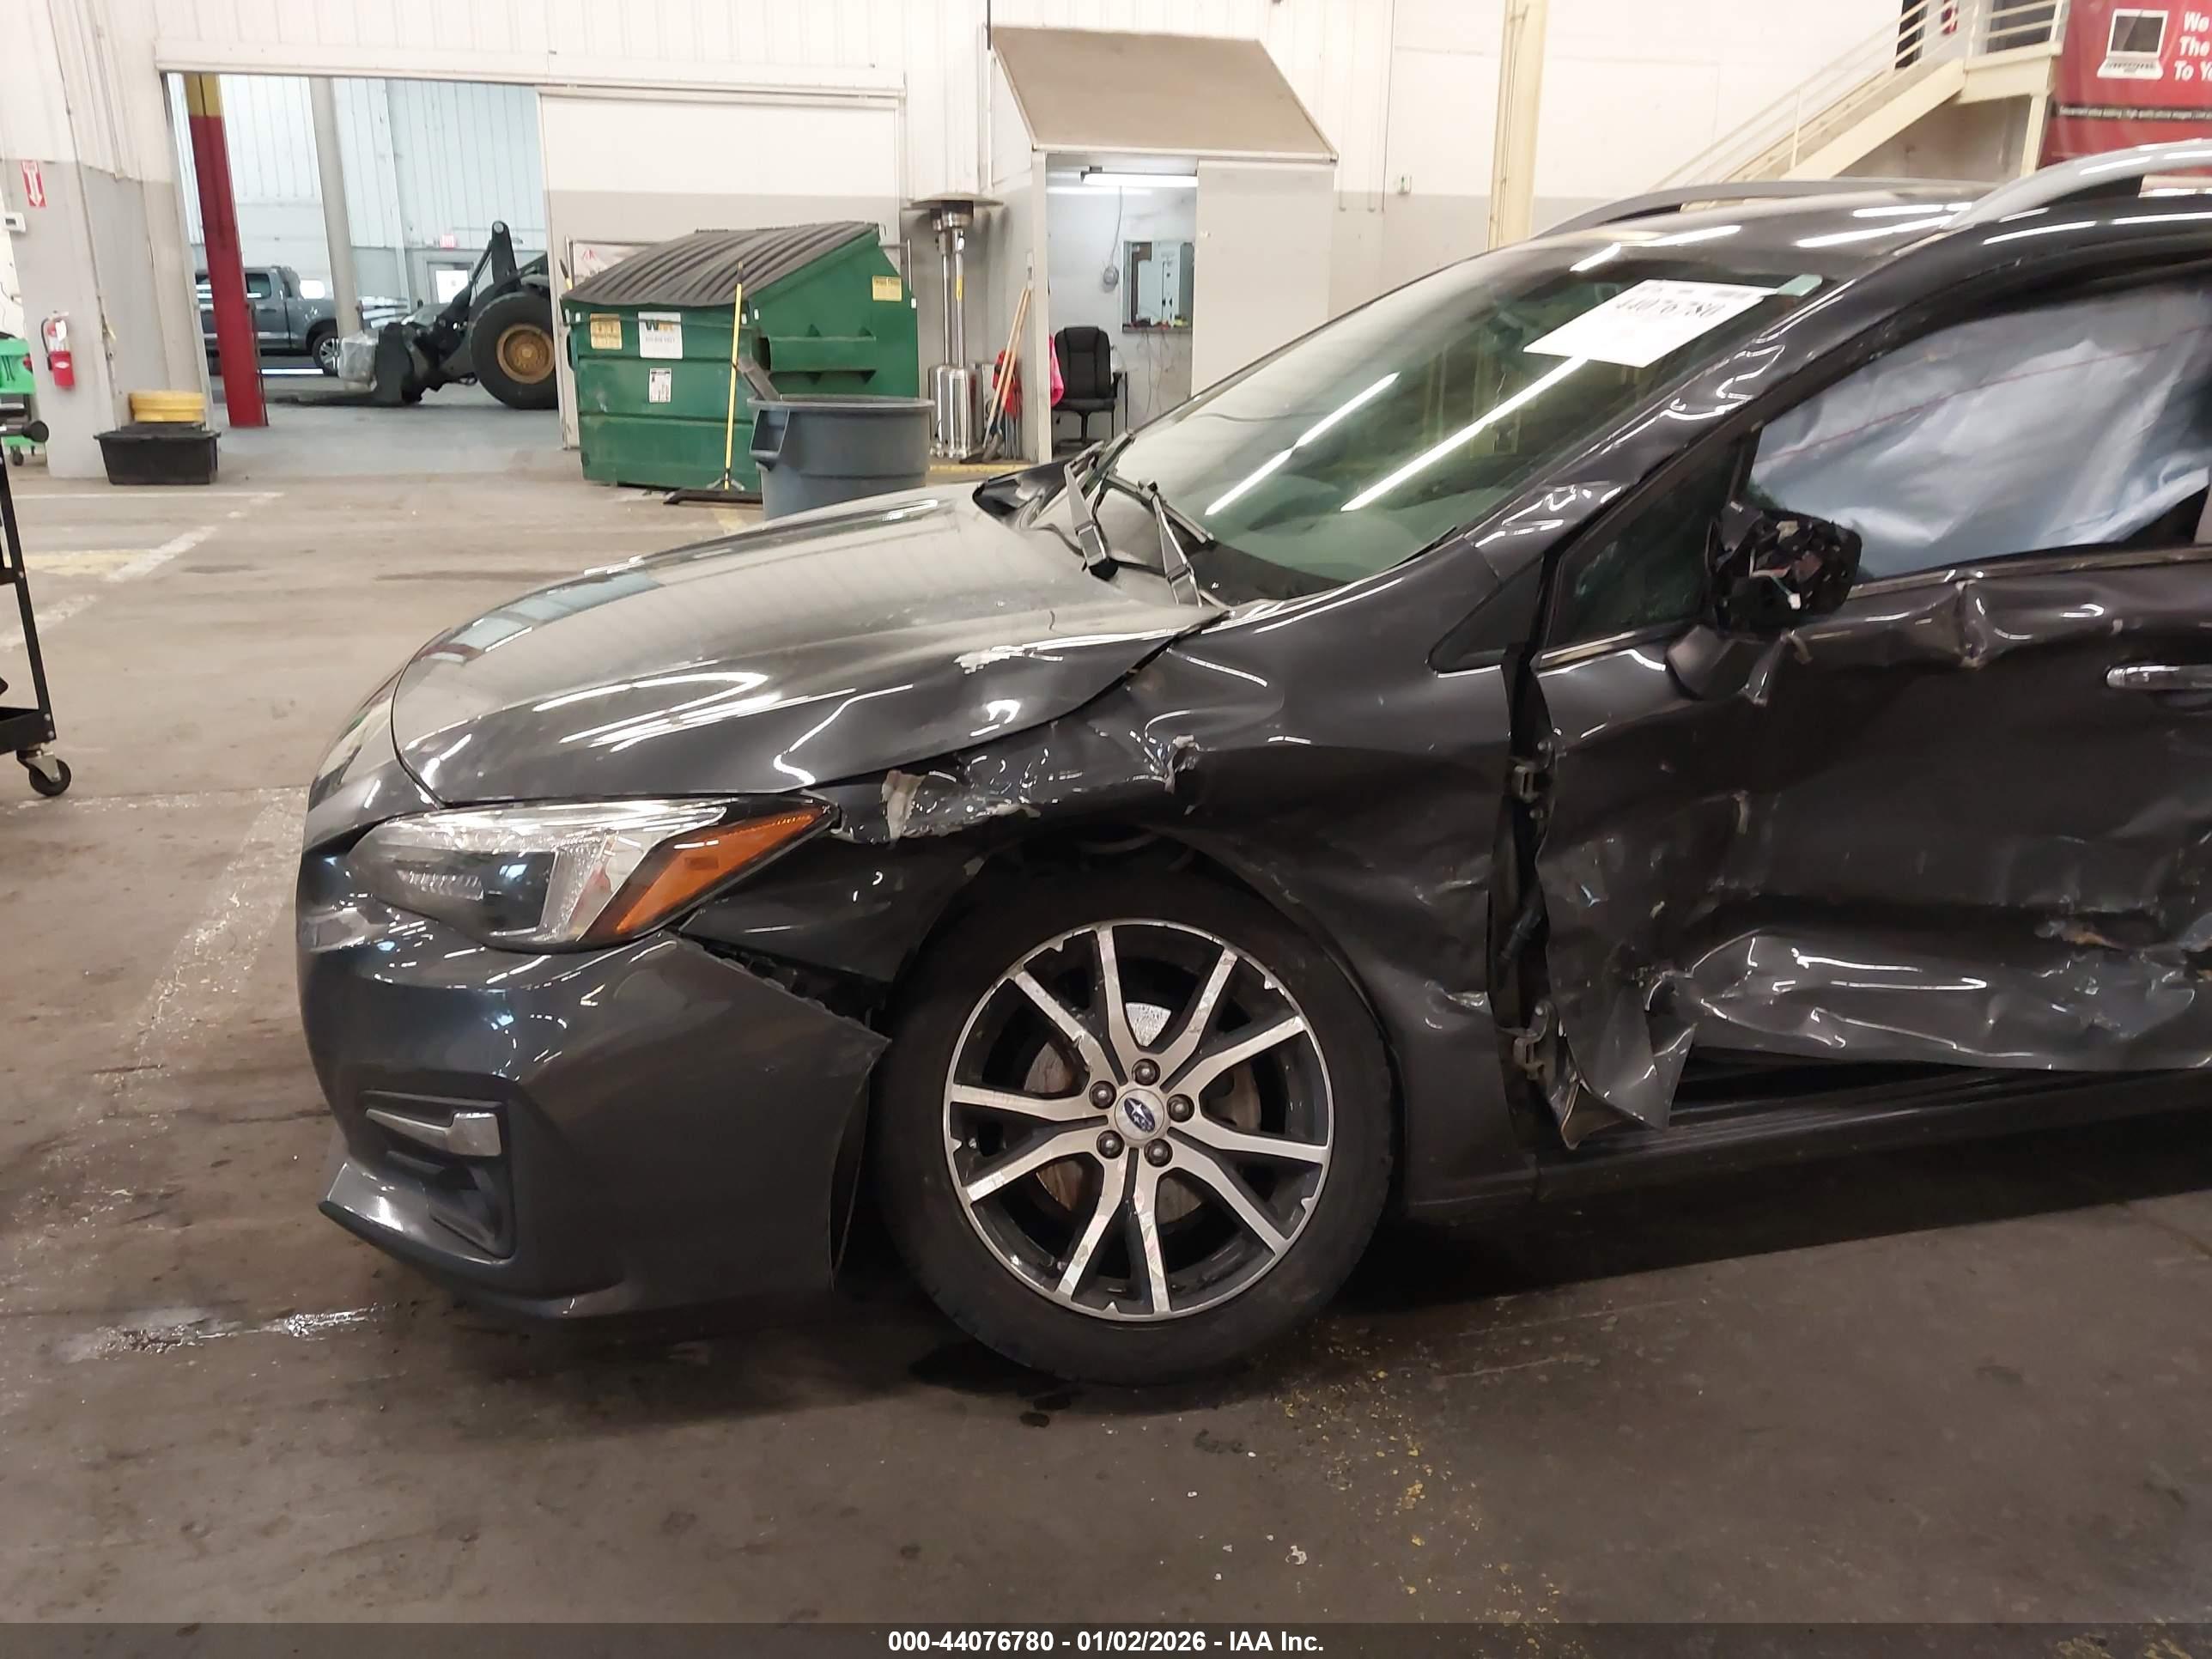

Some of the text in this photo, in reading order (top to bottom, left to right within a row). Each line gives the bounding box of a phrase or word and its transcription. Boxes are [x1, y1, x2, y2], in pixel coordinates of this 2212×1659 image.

[2184, 10, 2210, 33] We
[2179, 35, 2211, 58] The
[2174, 59, 2194, 82] To
